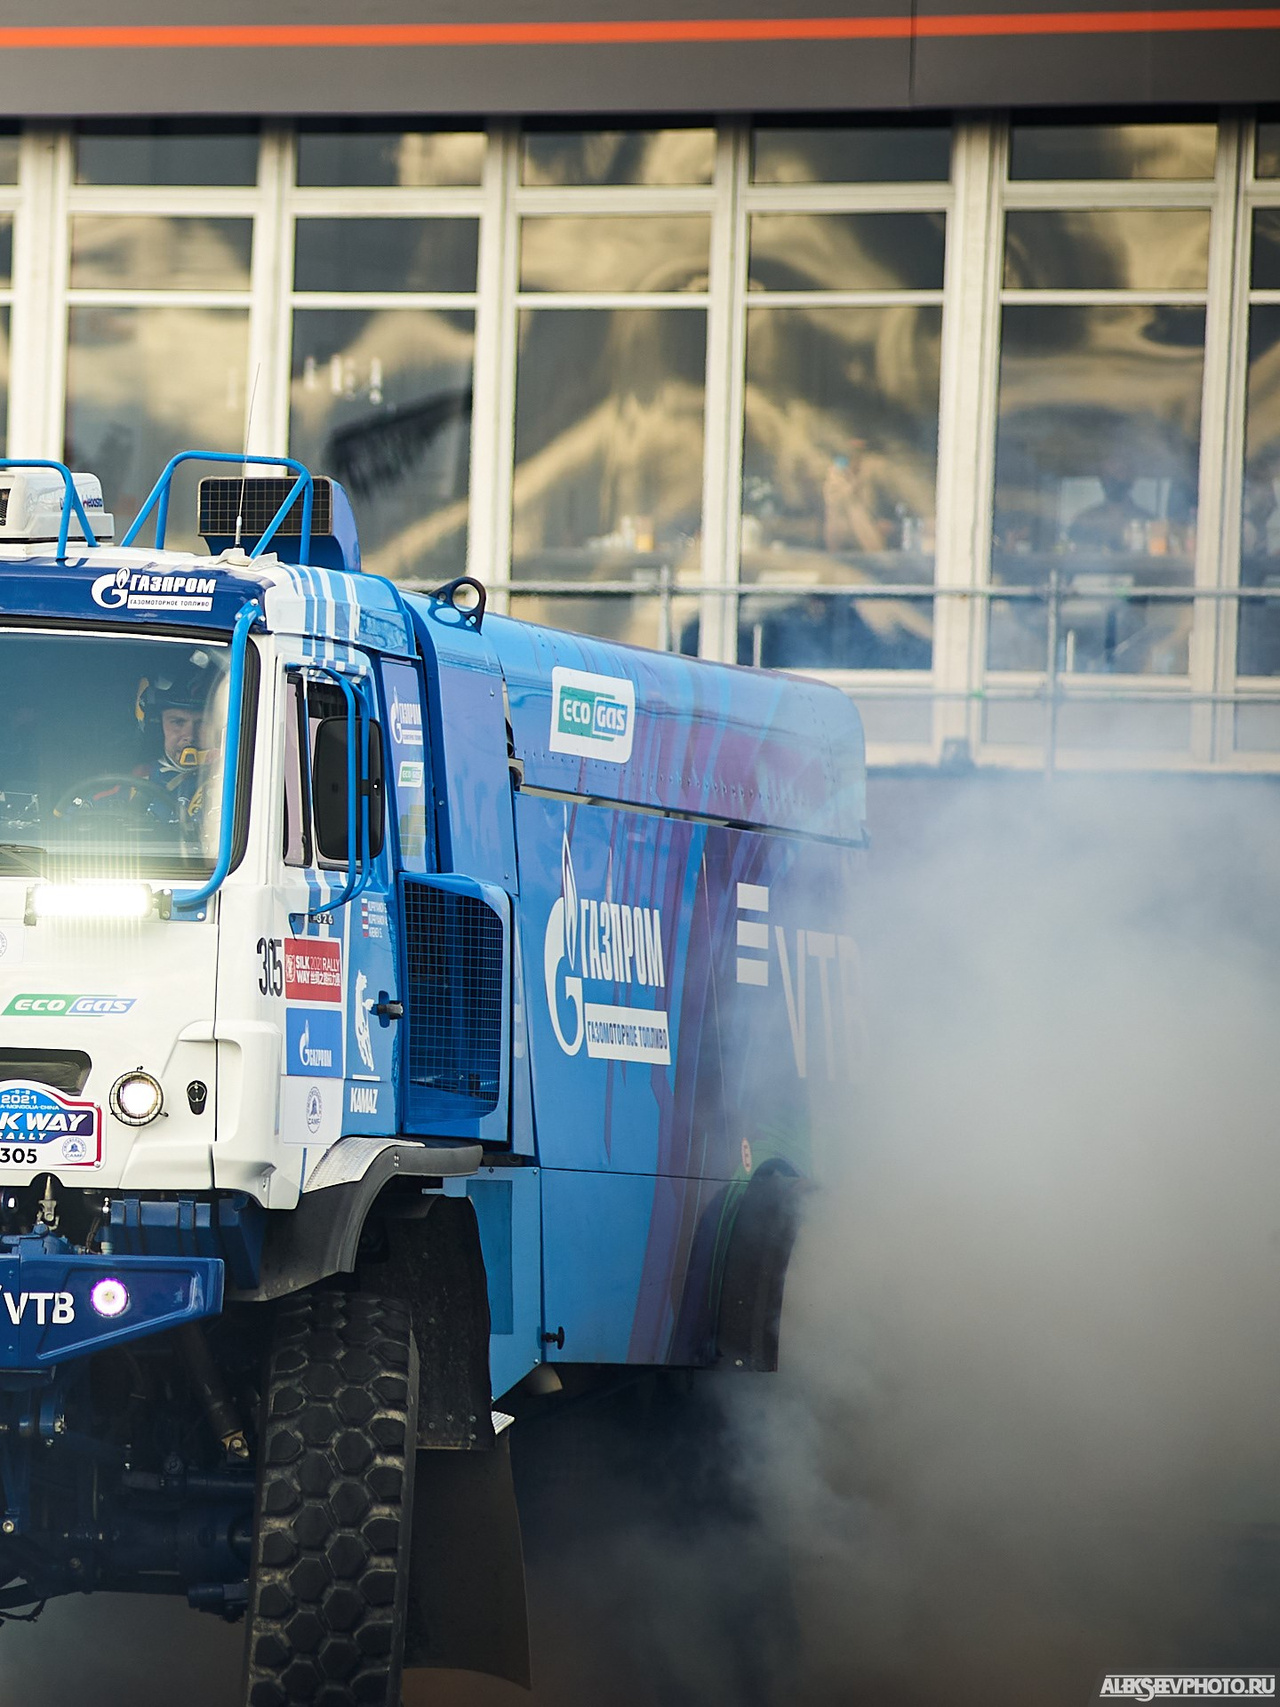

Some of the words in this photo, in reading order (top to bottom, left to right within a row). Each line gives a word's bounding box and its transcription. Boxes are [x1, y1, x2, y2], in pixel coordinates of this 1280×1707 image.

[129, 574, 217, 594] ГАЗПРОМ
[129, 598, 178, 607] ГАЗОМОТОРНОЕ
[180, 600, 210, 608] ТОПЛИВО
[563, 698, 591, 725] ECO
[580, 898, 666, 988] ГАЗПРОМ
[256, 937, 283, 997] 305
[295, 954, 310, 970] SILK
[322, 957, 341, 973] RALLY
[296, 969, 310, 984] WAY
[14, 998, 67, 1012] ECO
[1, 1094, 38, 1105] 2021
[350, 1087, 379, 1115] KAMAZ
[26, 1111, 88, 1132] WAY
[0, 1147, 38, 1164] 305
[3, 1292, 76, 1325] VTB
